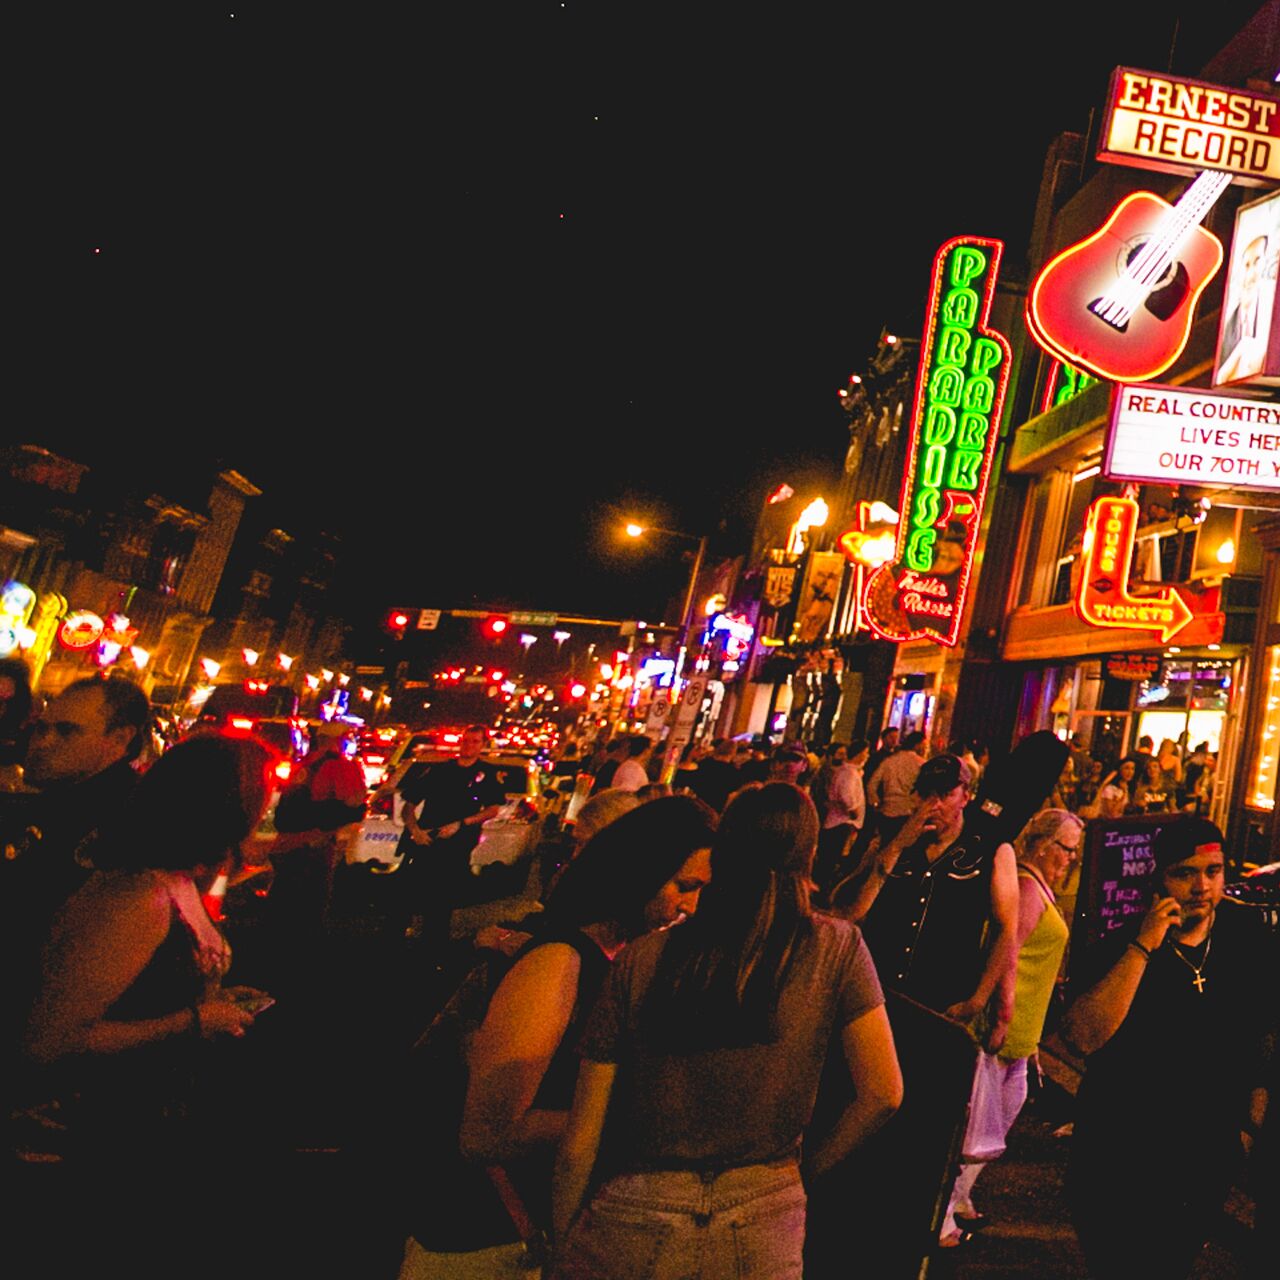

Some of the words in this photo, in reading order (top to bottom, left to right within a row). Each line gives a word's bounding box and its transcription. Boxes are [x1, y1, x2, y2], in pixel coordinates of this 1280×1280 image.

[1119, 72, 1276, 133] ERNEST
[1134, 119, 1272, 172] RECORD
[904, 246, 987, 573] PARADISE
[947, 337, 1003, 491] PARK
[1127, 394, 1184, 417] REAL
[1180, 427, 1240, 447] LIVES
[1158, 451, 1202, 471] OUR
[1209, 456, 1259, 477] 70TH
[1100, 505, 1125, 573] TOURS
[1093, 603, 1175, 622] TICKETS
